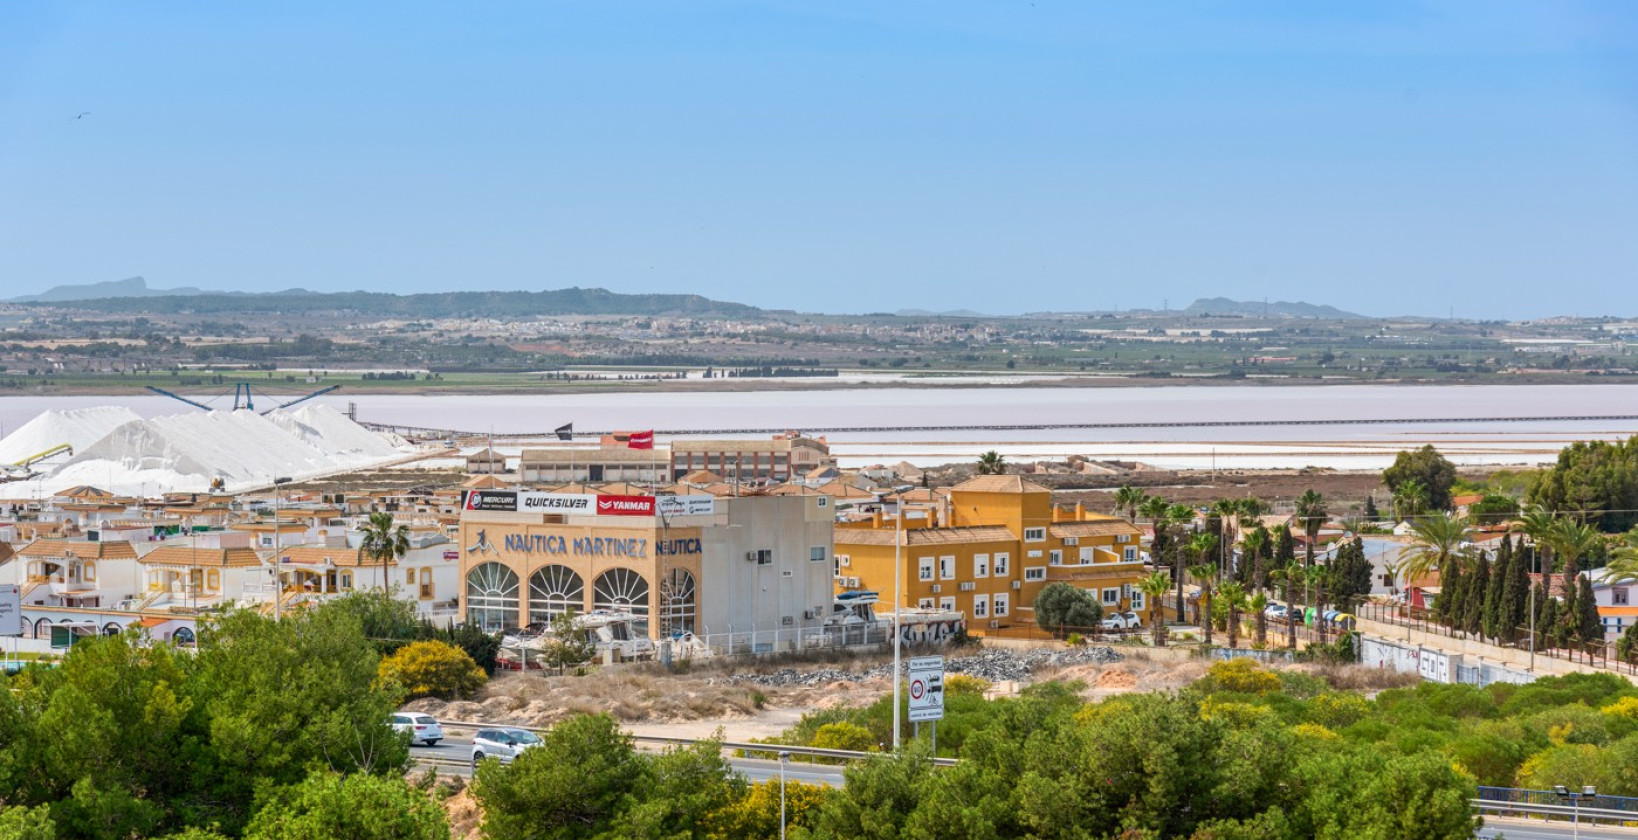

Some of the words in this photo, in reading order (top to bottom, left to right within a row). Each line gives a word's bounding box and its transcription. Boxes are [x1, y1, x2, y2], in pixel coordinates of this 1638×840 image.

[483, 496, 515, 504] MERCURY
[525, 497, 588, 508] QUICKSILVER
[613, 501, 651, 511] YANMAR
[505, 534, 567, 554] NAUTICA
[573, 537, 647, 558] MARTINEZ
